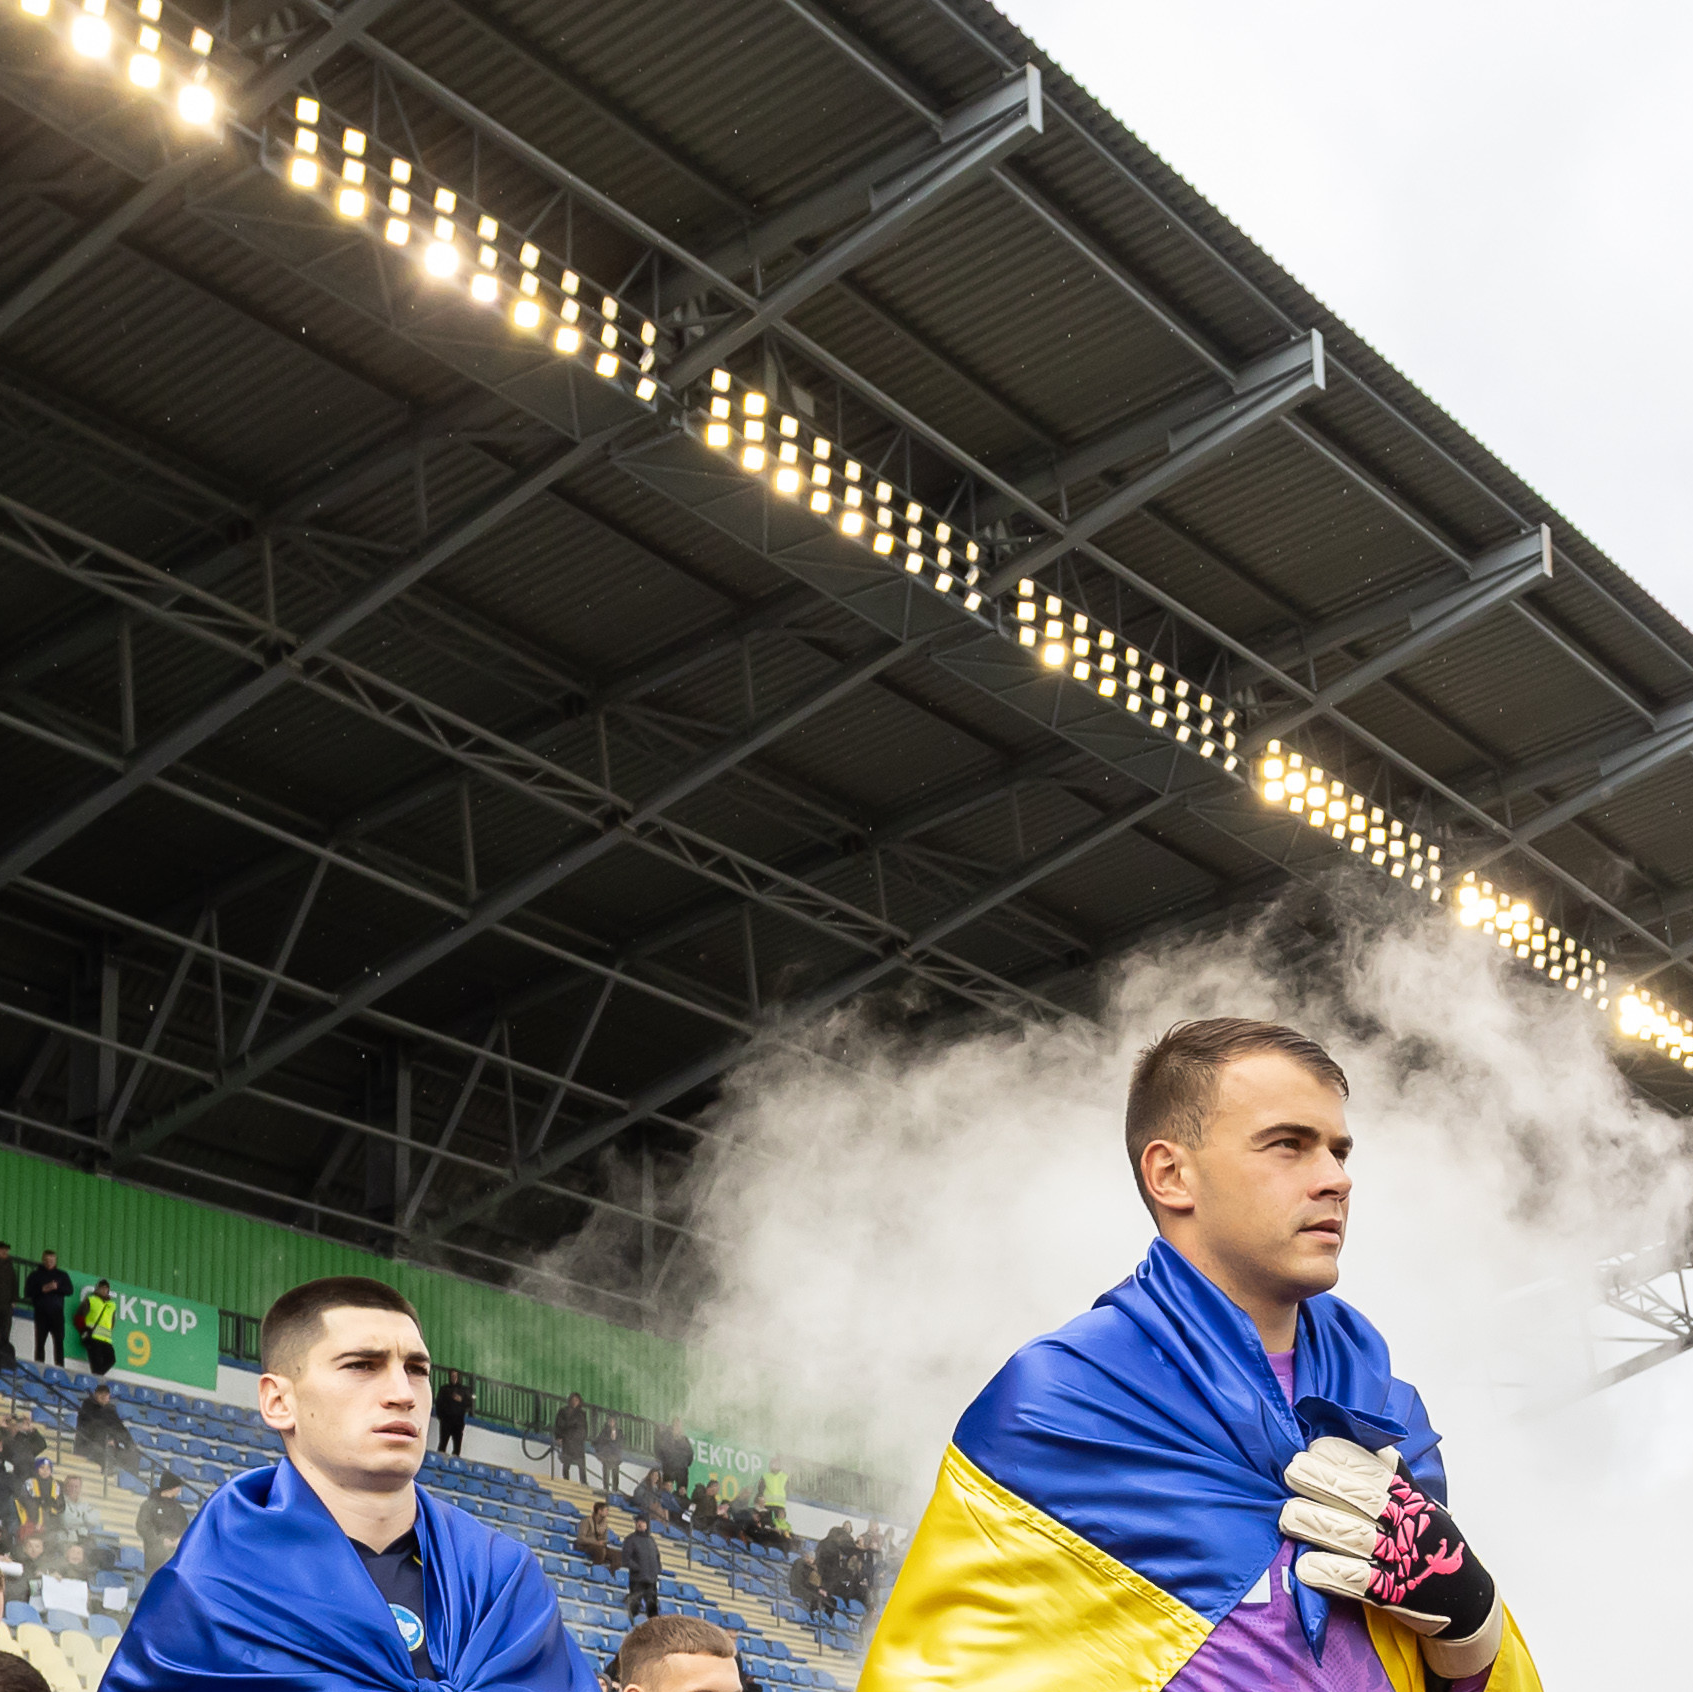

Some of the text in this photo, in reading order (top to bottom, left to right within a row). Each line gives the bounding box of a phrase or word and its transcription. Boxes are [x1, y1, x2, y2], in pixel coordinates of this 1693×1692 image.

[80, 1285, 198, 1335] КТОР
[126, 1330, 152, 1367] 9
[688, 1436, 763, 1477] ЕКТОР
